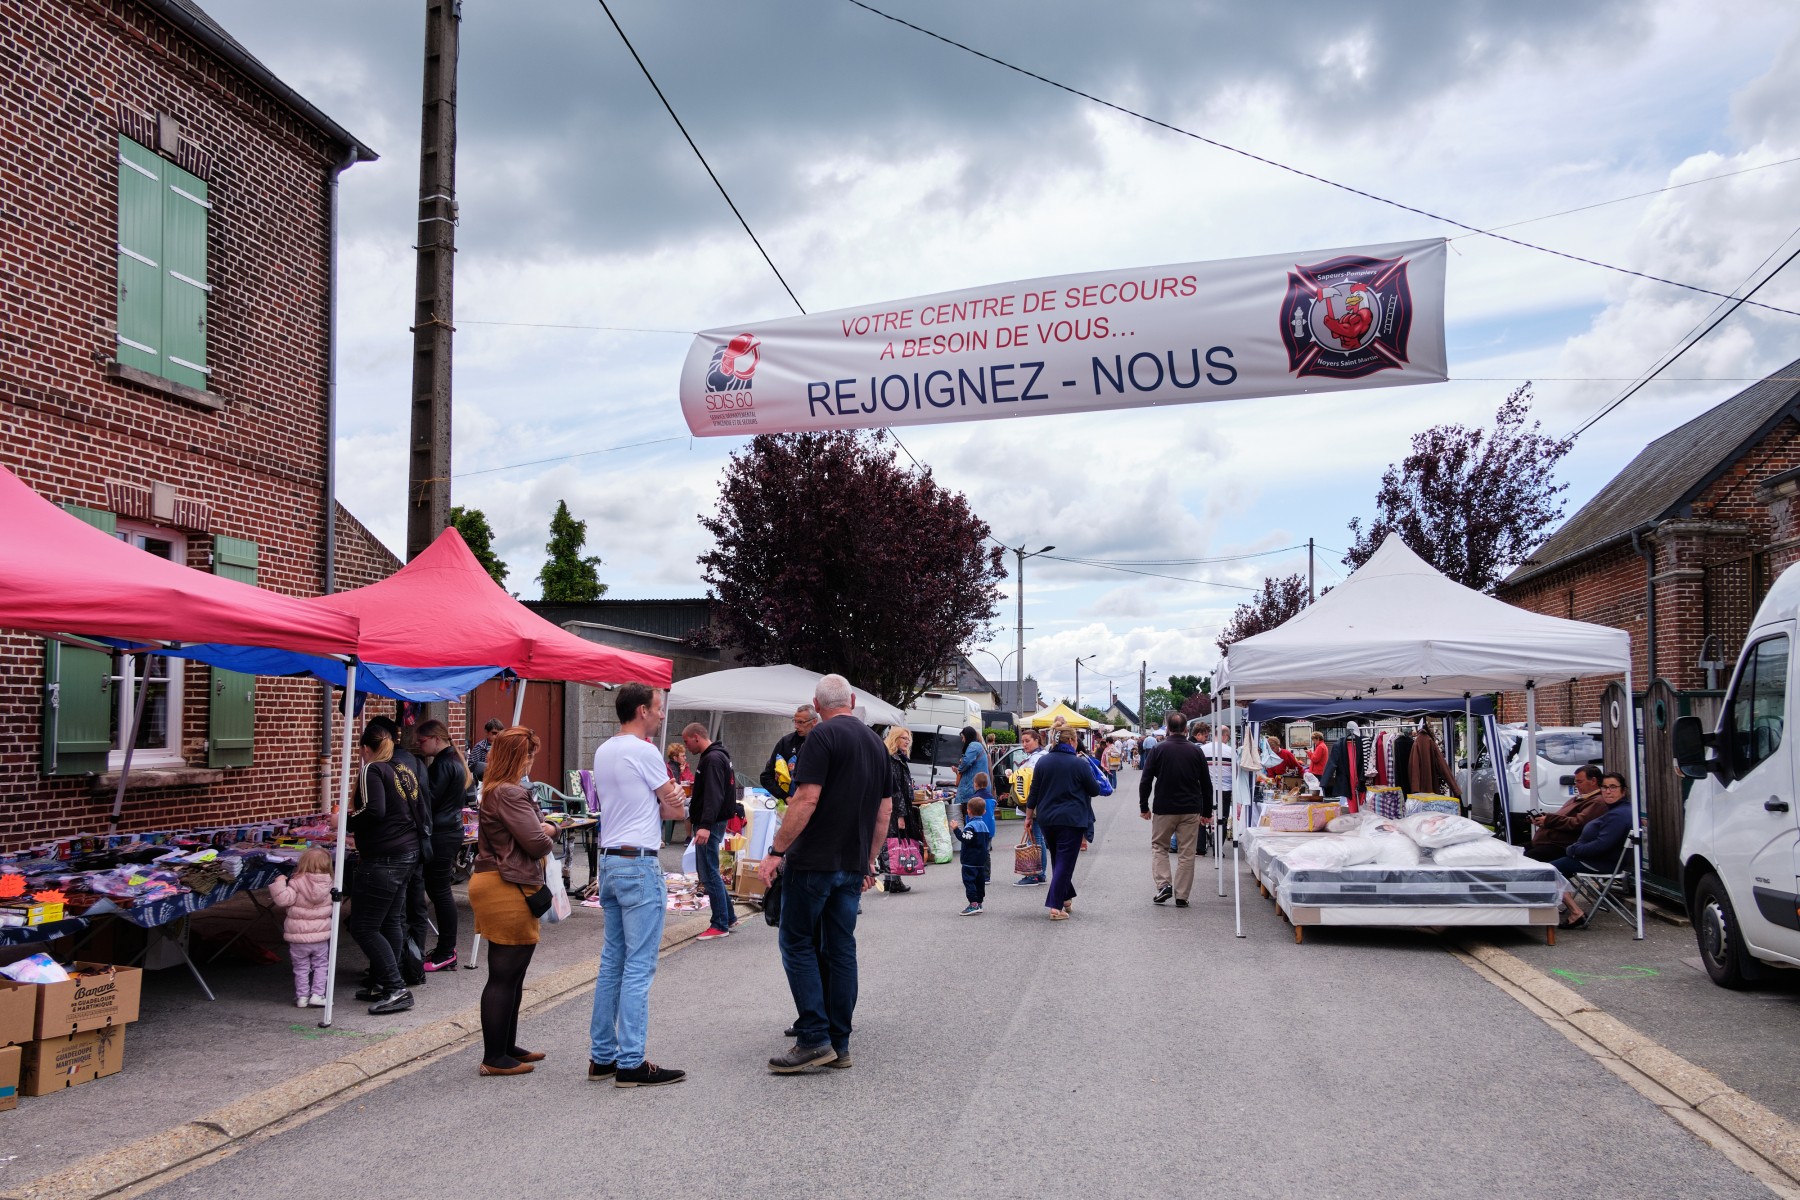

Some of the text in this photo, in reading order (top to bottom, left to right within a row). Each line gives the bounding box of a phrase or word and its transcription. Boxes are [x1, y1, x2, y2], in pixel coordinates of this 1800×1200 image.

[1317, 270, 1377, 280] Sapeurs-Pompiers
[842, 275, 1197, 337] VOTRE CENTRE DE SECOURS
[880, 316, 1135, 360] A BESOIN DE VOUS...
[1317, 355, 1378, 367] Noyers Saint Martin
[808, 362, 1048, 417] REJOIGNEZ
[1092, 346, 1237, 395] NOUS
[706, 392, 753, 410] SDIS 60
[74, 982, 118, 1000] Banane
[77, 1001, 112, 1012] MARTINIQUE
[78, 995, 115, 1006] GUADELOUPE
[56, 1046, 92, 1061] GUADELOUPE
[56, 1054, 92, 1069] MARTINIQUE
